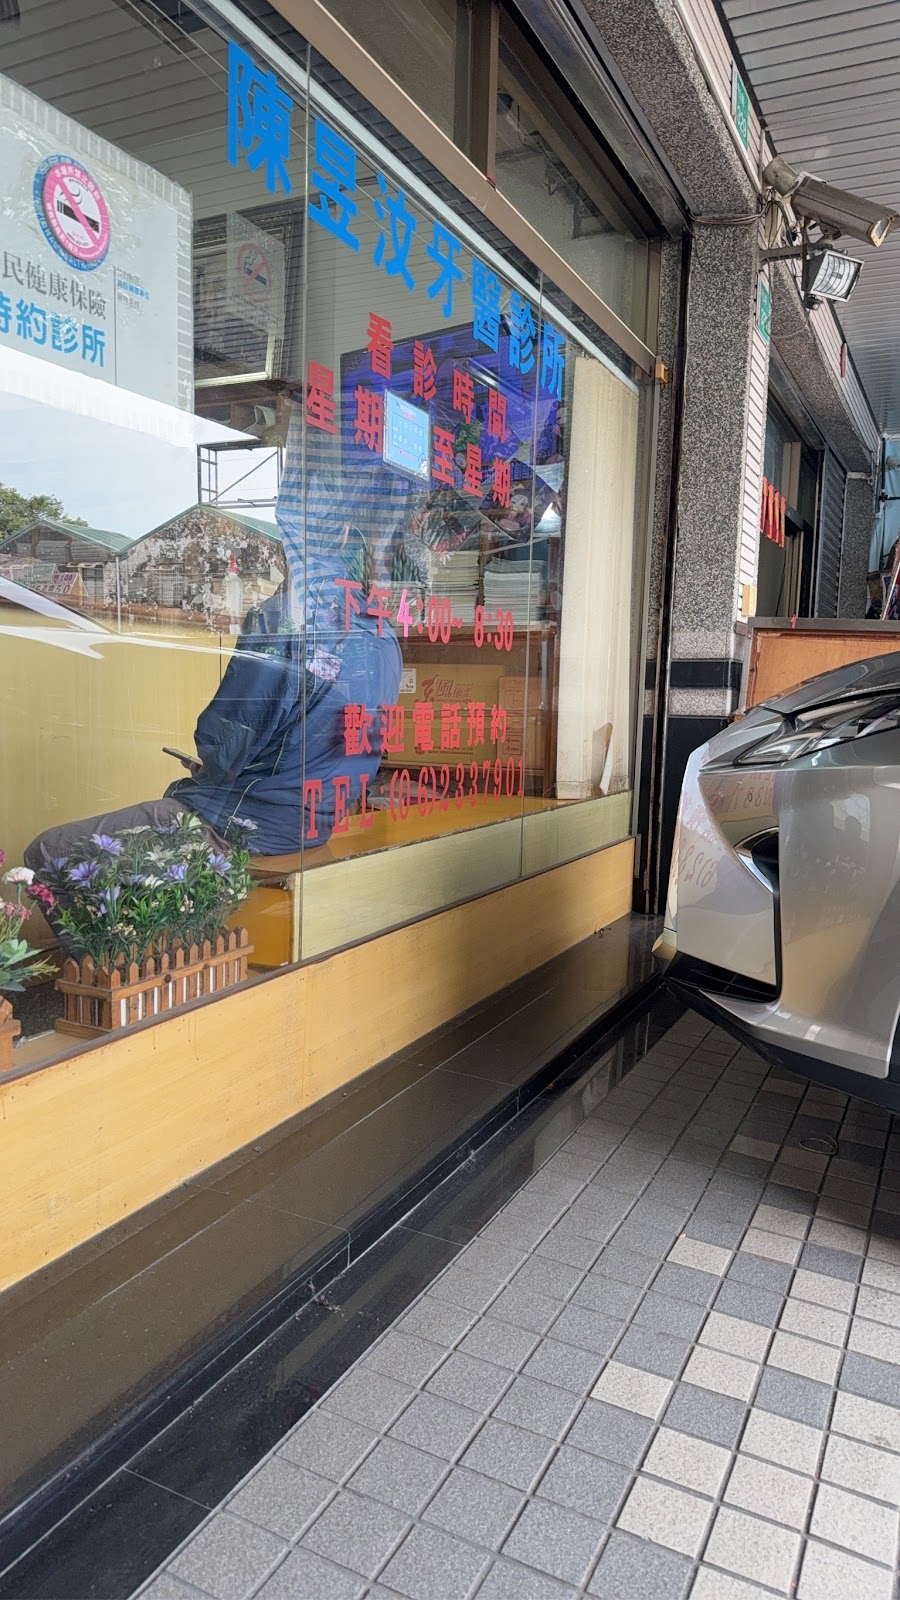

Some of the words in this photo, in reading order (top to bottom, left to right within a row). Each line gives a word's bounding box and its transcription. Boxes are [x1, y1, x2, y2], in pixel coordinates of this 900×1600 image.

[2, 251, 107, 320] 民健康保險
[366, 311, 508, 444] 看診時間
[306, 360, 383, 453] 星期
[431, 425, 511, 509] 至星期
[343, 701, 508, 757] 歡迎電話預約
